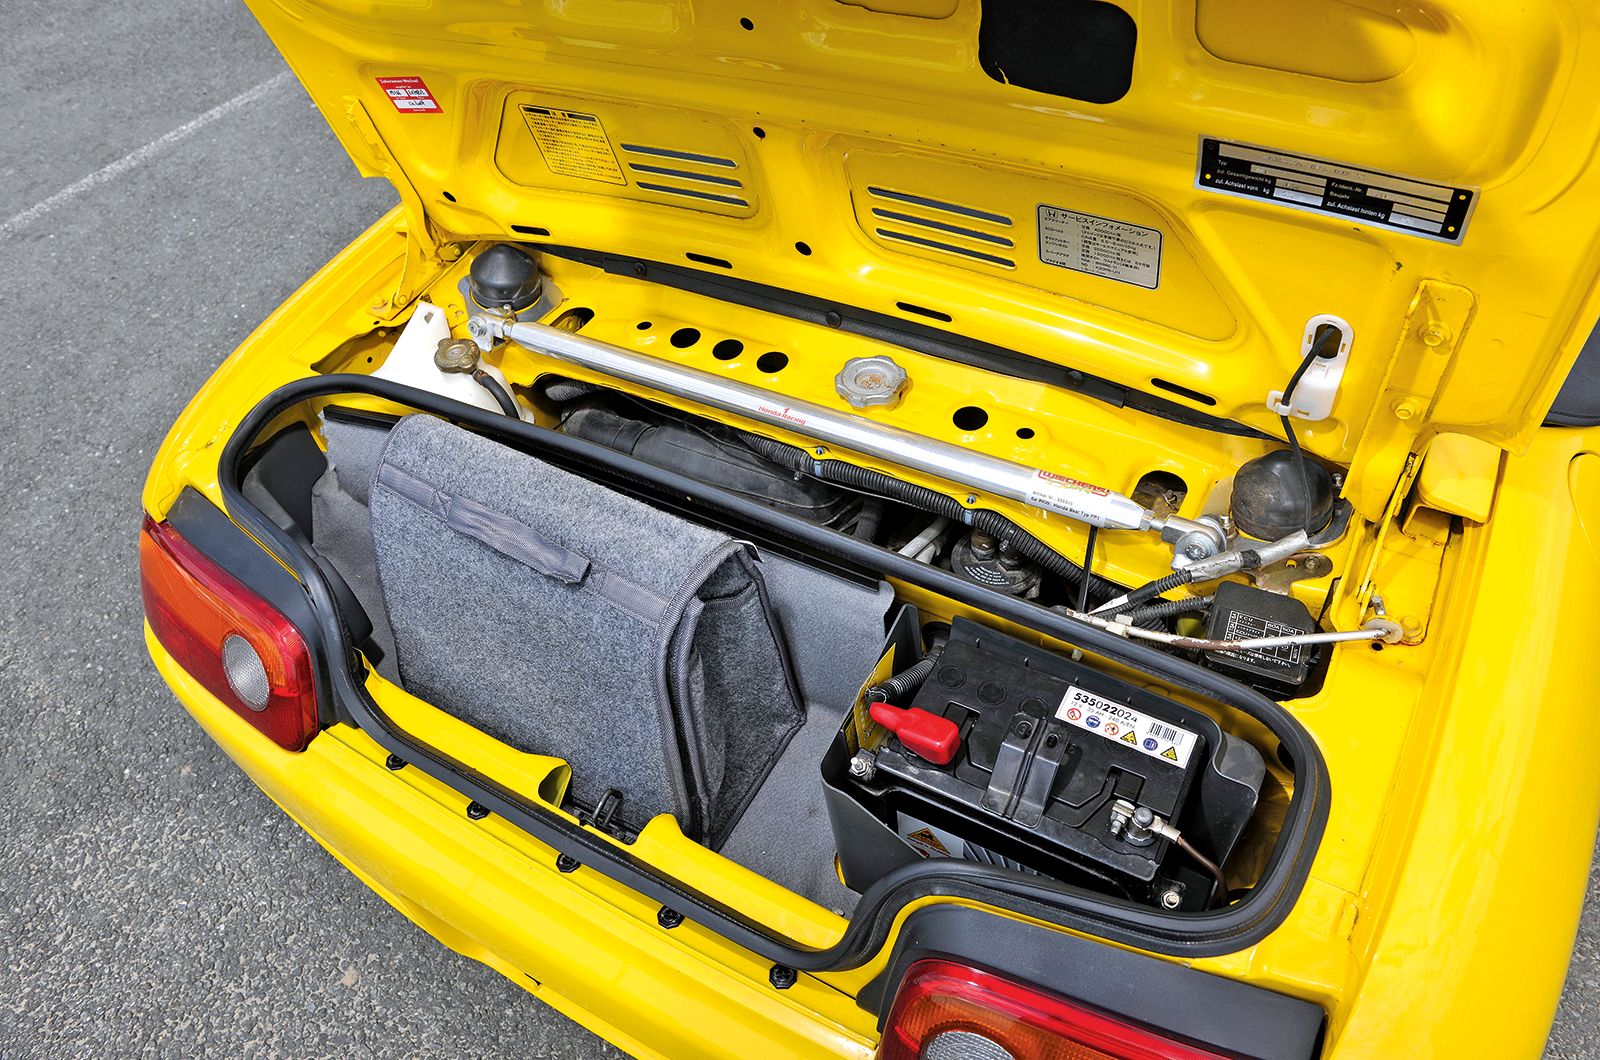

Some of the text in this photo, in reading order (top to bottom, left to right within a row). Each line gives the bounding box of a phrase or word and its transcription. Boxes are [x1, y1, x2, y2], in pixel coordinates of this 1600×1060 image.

[1218, 159, 1227, 167] Typ
[1227, 170, 1264, 182] Gesamtgewicht
[1225, 181, 1246, 189] Achslast
[1263, 187, 1271, 195] kg
[1329, 191, 1350, 199] Baujahr
[1338, 203, 1361, 213] Achslast
[1361, 208, 1378, 217] hinten
[1061, 213, 1149, 237] サービスインフォメーション
[758, 406, 807, 426] Honda Racing
[1053, 502, 1069, 511] Honda
[1081, 510, 1089, 518] Typ
[1073, 692, 1138, 723] 535022024
